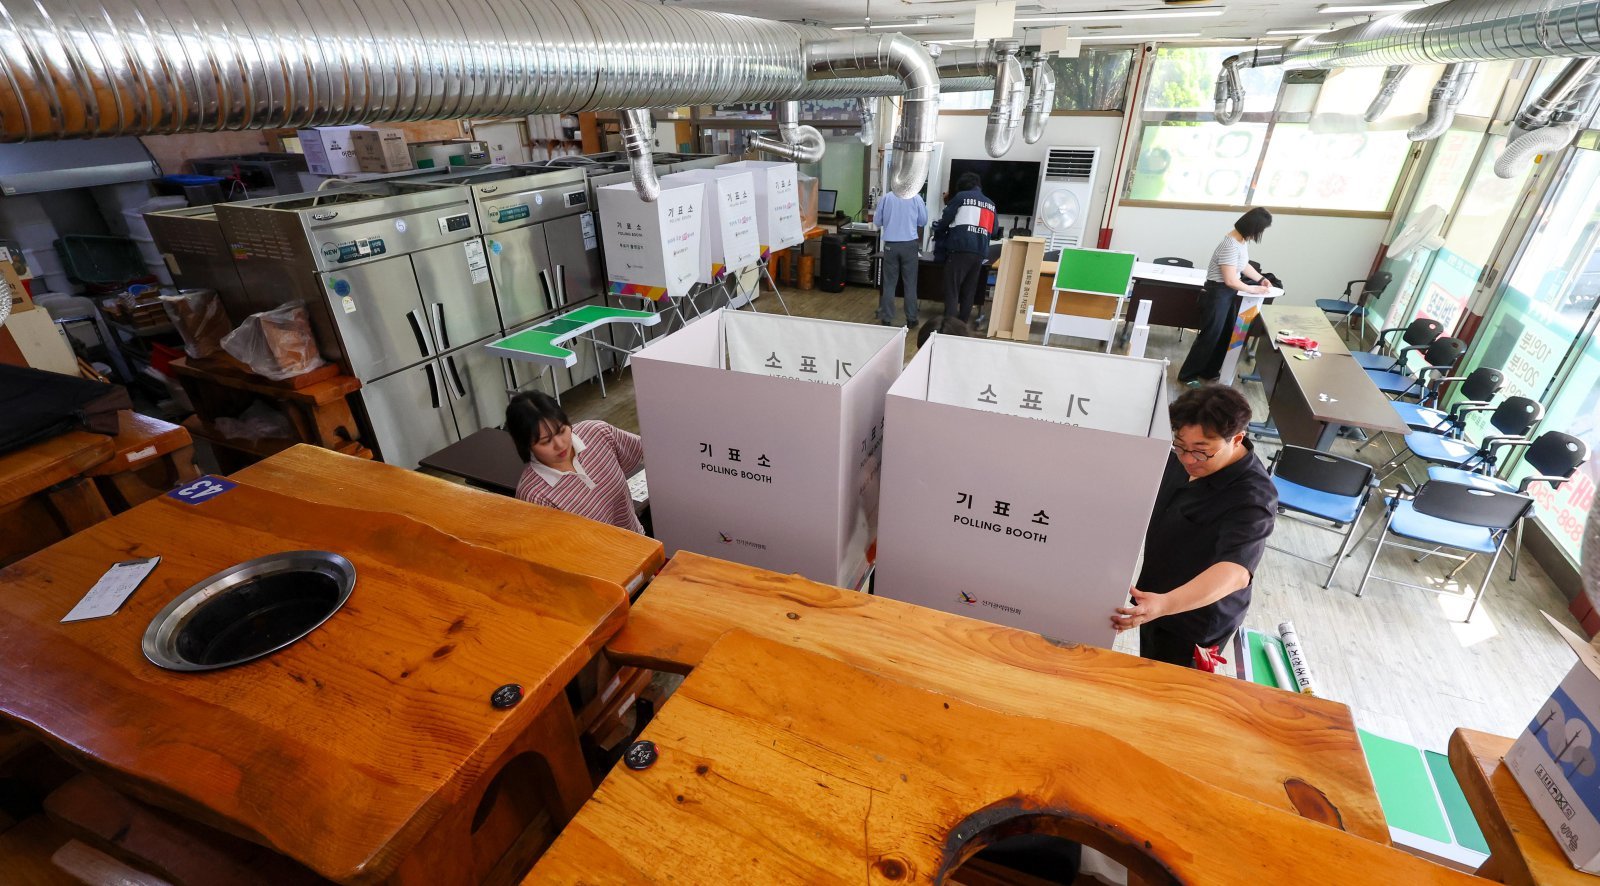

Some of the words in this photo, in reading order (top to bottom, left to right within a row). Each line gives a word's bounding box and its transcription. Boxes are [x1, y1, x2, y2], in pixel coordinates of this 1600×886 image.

[323, 248, 338, 257] NEW
[701, 462, 739, 477] POLLING
[740, 470, 772, 484] BOOTH
[178, 480, 224, 499] 43
[953, 514, 1002, 533] POLLING
[1005, 526, 1048, 544] BOOTH
[982, 600, 1022, 616] 선거관리위원회
